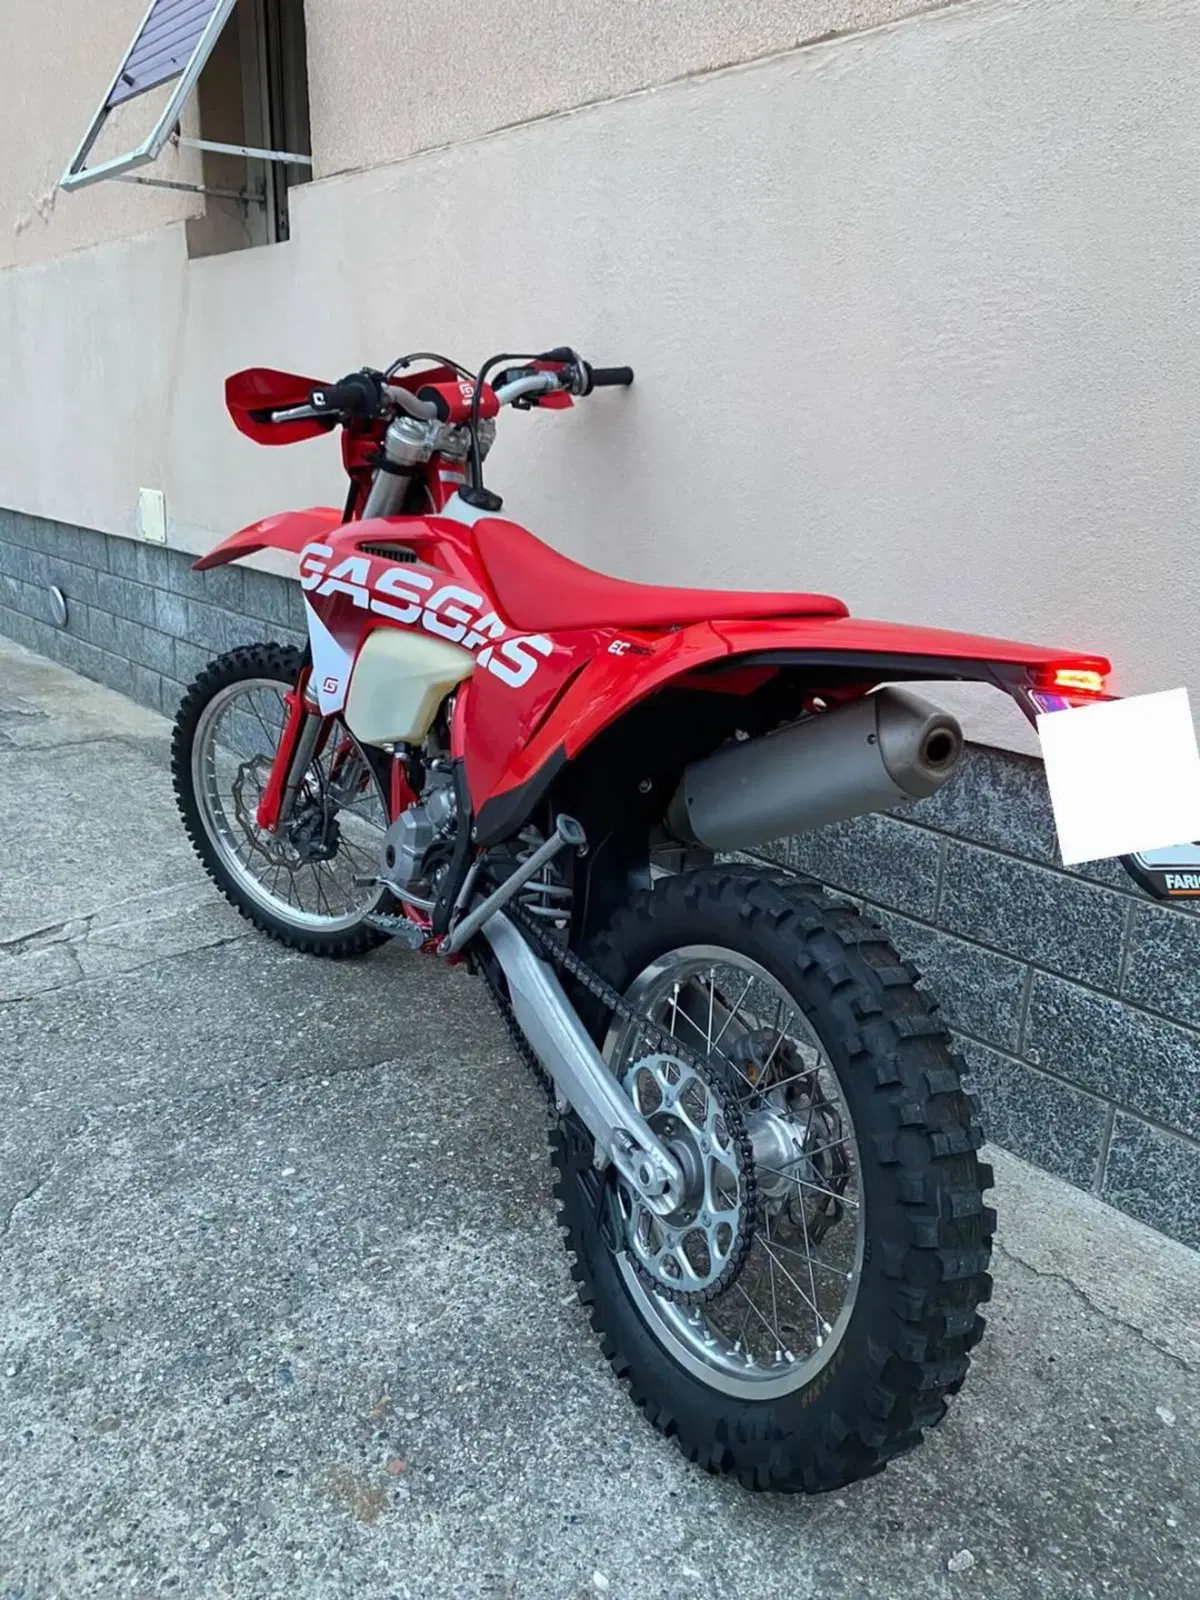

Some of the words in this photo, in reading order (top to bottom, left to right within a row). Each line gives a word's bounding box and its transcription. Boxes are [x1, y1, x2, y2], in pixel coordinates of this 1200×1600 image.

[299, 543, 554, 689] GASGAS
[607, 639, 631, 656] EC
[1164, 873, 1200, 890] FARI
